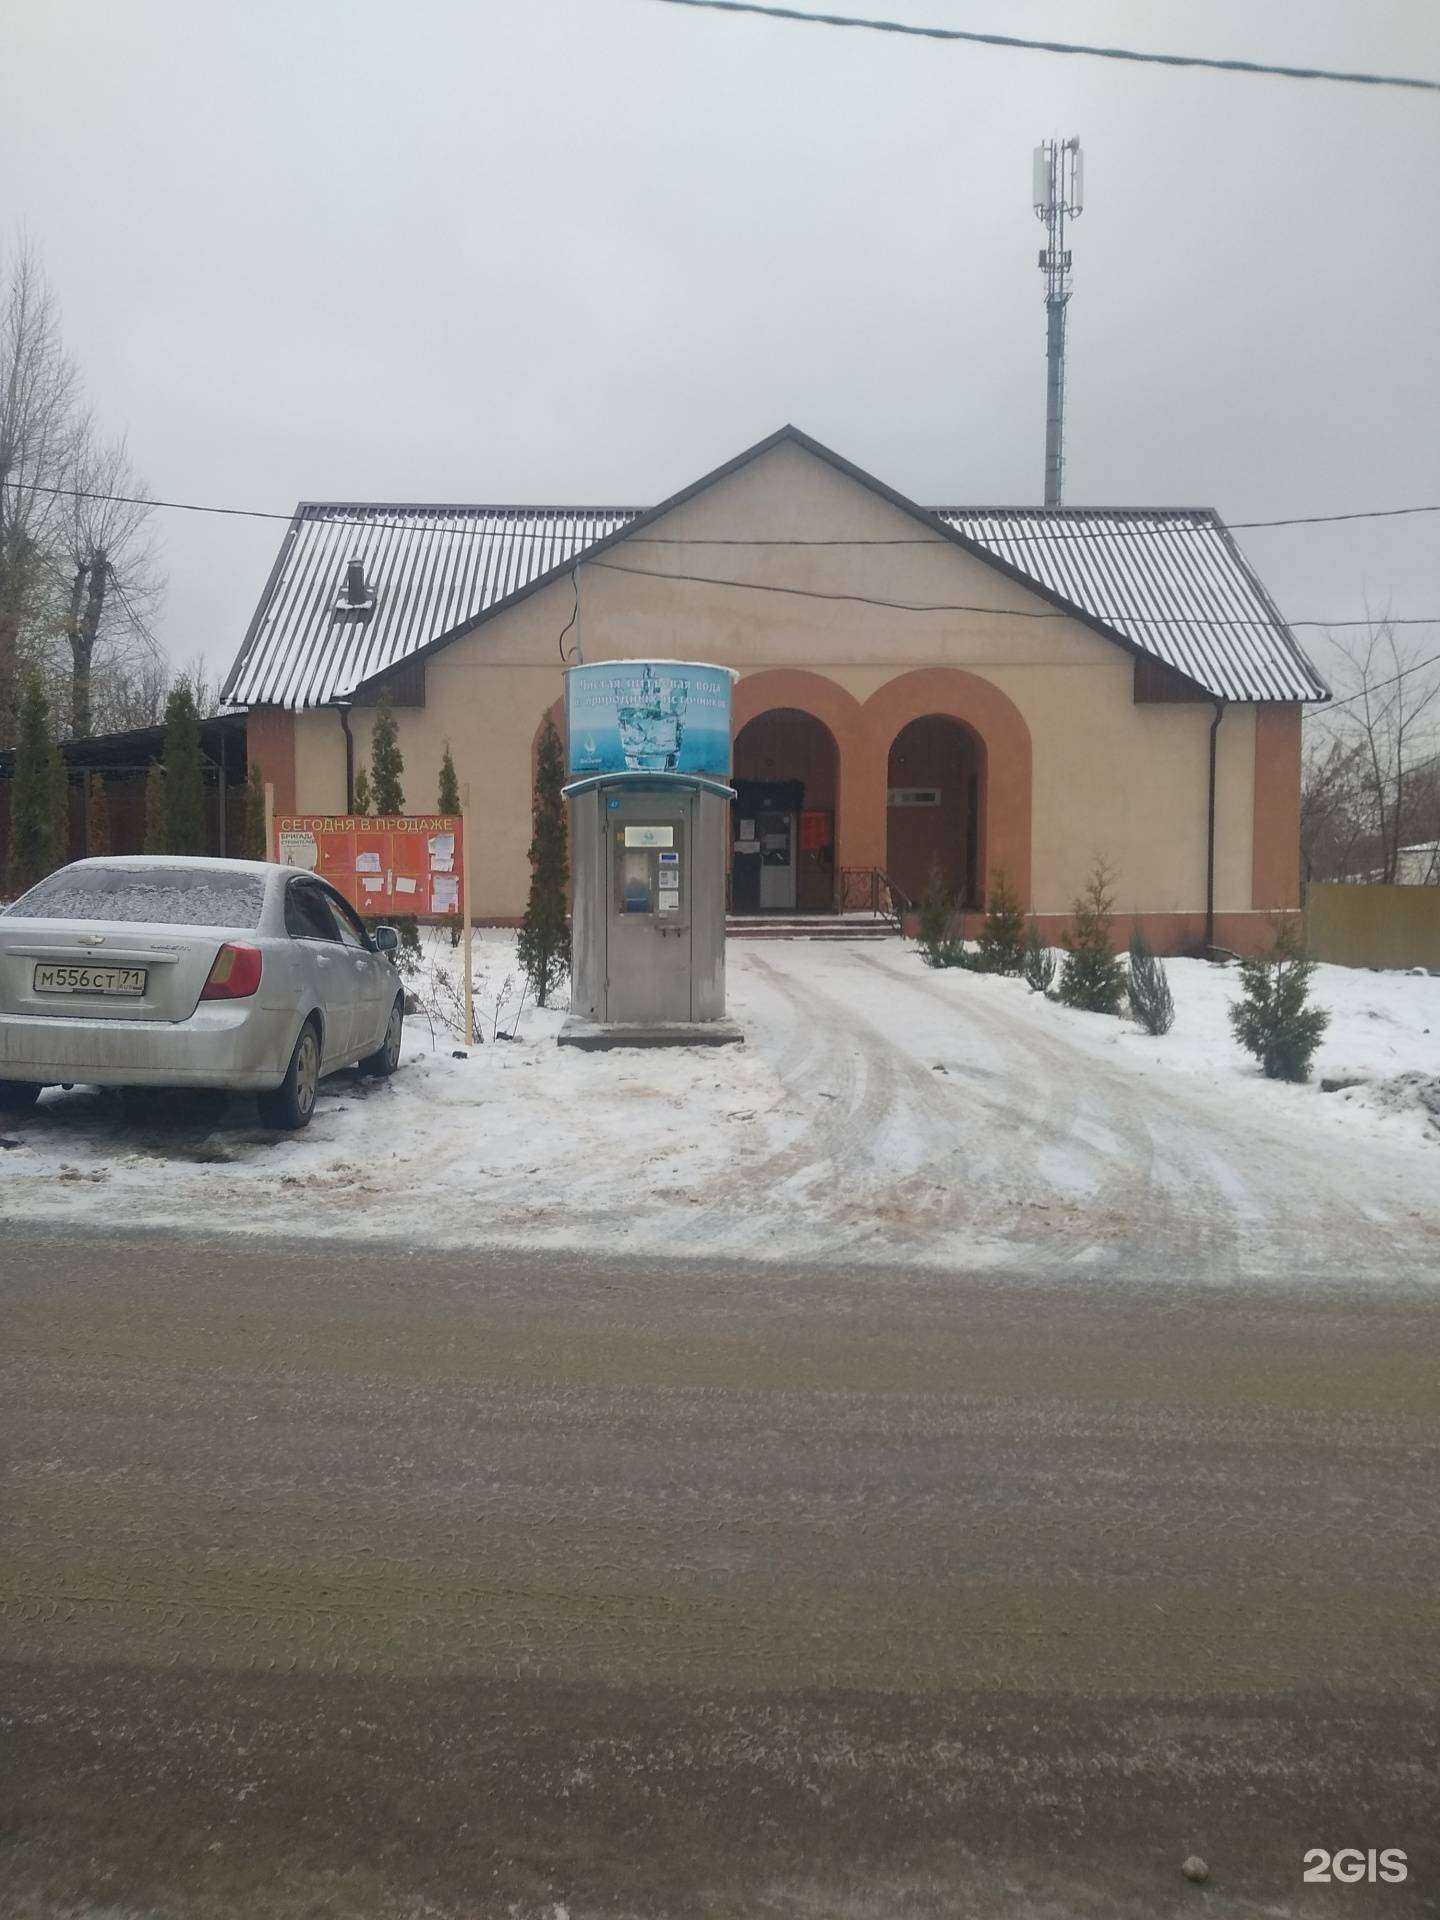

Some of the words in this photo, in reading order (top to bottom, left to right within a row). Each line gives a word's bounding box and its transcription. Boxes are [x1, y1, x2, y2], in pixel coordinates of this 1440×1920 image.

[280, 818, 356, 833] СЕГОДНЯ
[360, 818, 371, 831] В
[376, 818, 453, 833] ПРОДАЖЕ
